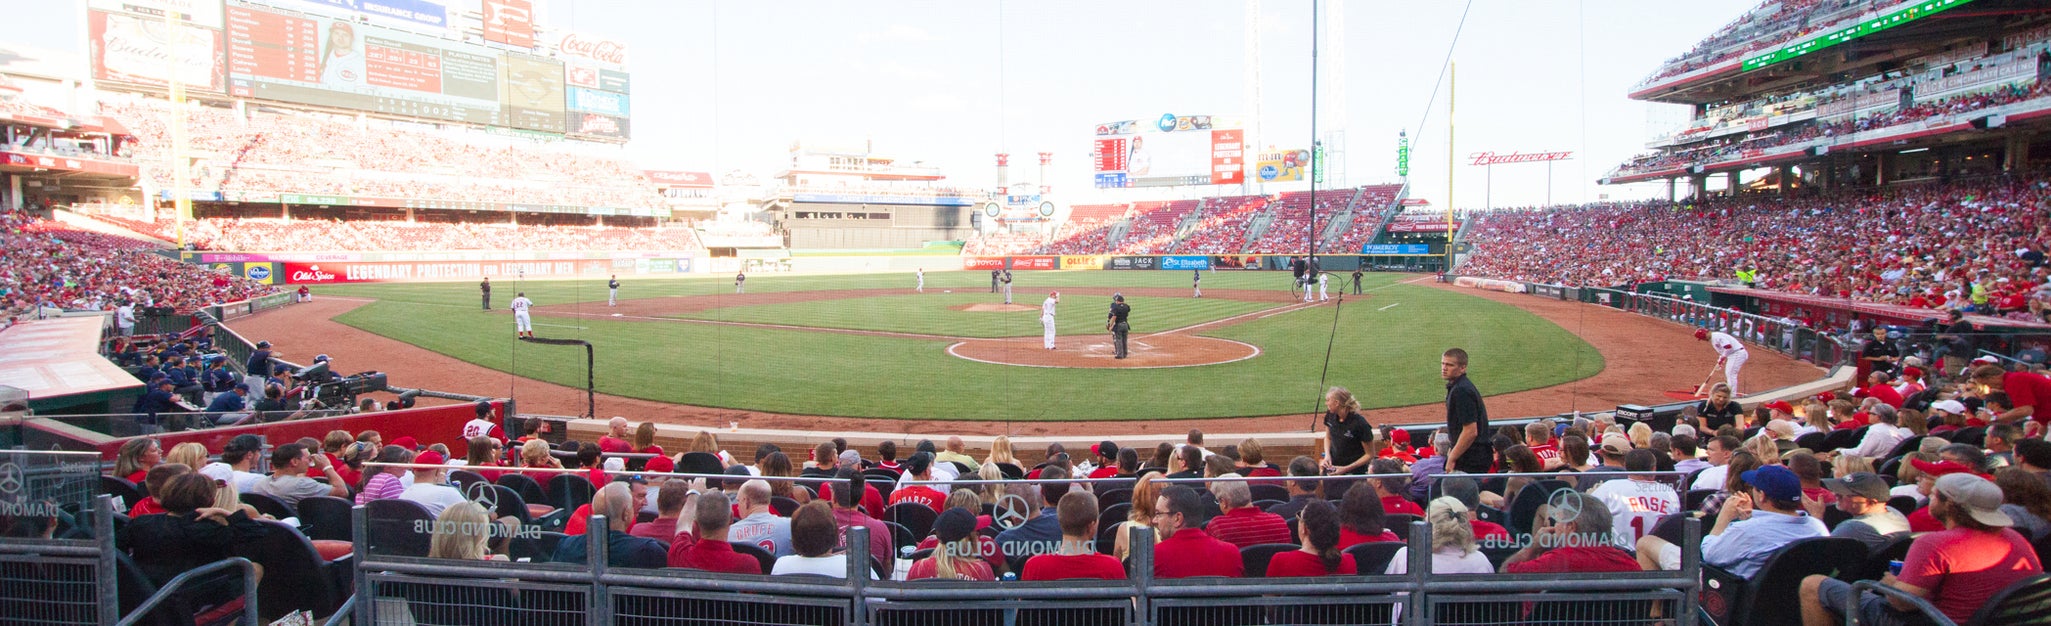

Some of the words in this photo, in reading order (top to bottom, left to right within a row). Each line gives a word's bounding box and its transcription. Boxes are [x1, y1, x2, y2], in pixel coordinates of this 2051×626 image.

[364, 3, 412, 18] INSURANCE
[414, 12, 441, 23] GROUP
[448, 51, 468, 59] PLAYER
[469, 54, 490, 63] NOTES
[1467, 150, 1574, 166] Budweiser
[293, 270, 311, 281] Old
[311, 270, 335, 282] Spice
[346, 264, 412, 280] LEGENDARY
[417, 263, 481, 279] PROTECTION
[484, 265, 498, 275] FOR
[555, 262, 574, 274] MEN
[466, 425, 480, 437] 20
[61, 461, 91, 473] Section
[1636, 482, 1674, 493] Section
[1675, 481, 1682, 492] 2
[1629, 496, 1669, 514] ROSE
